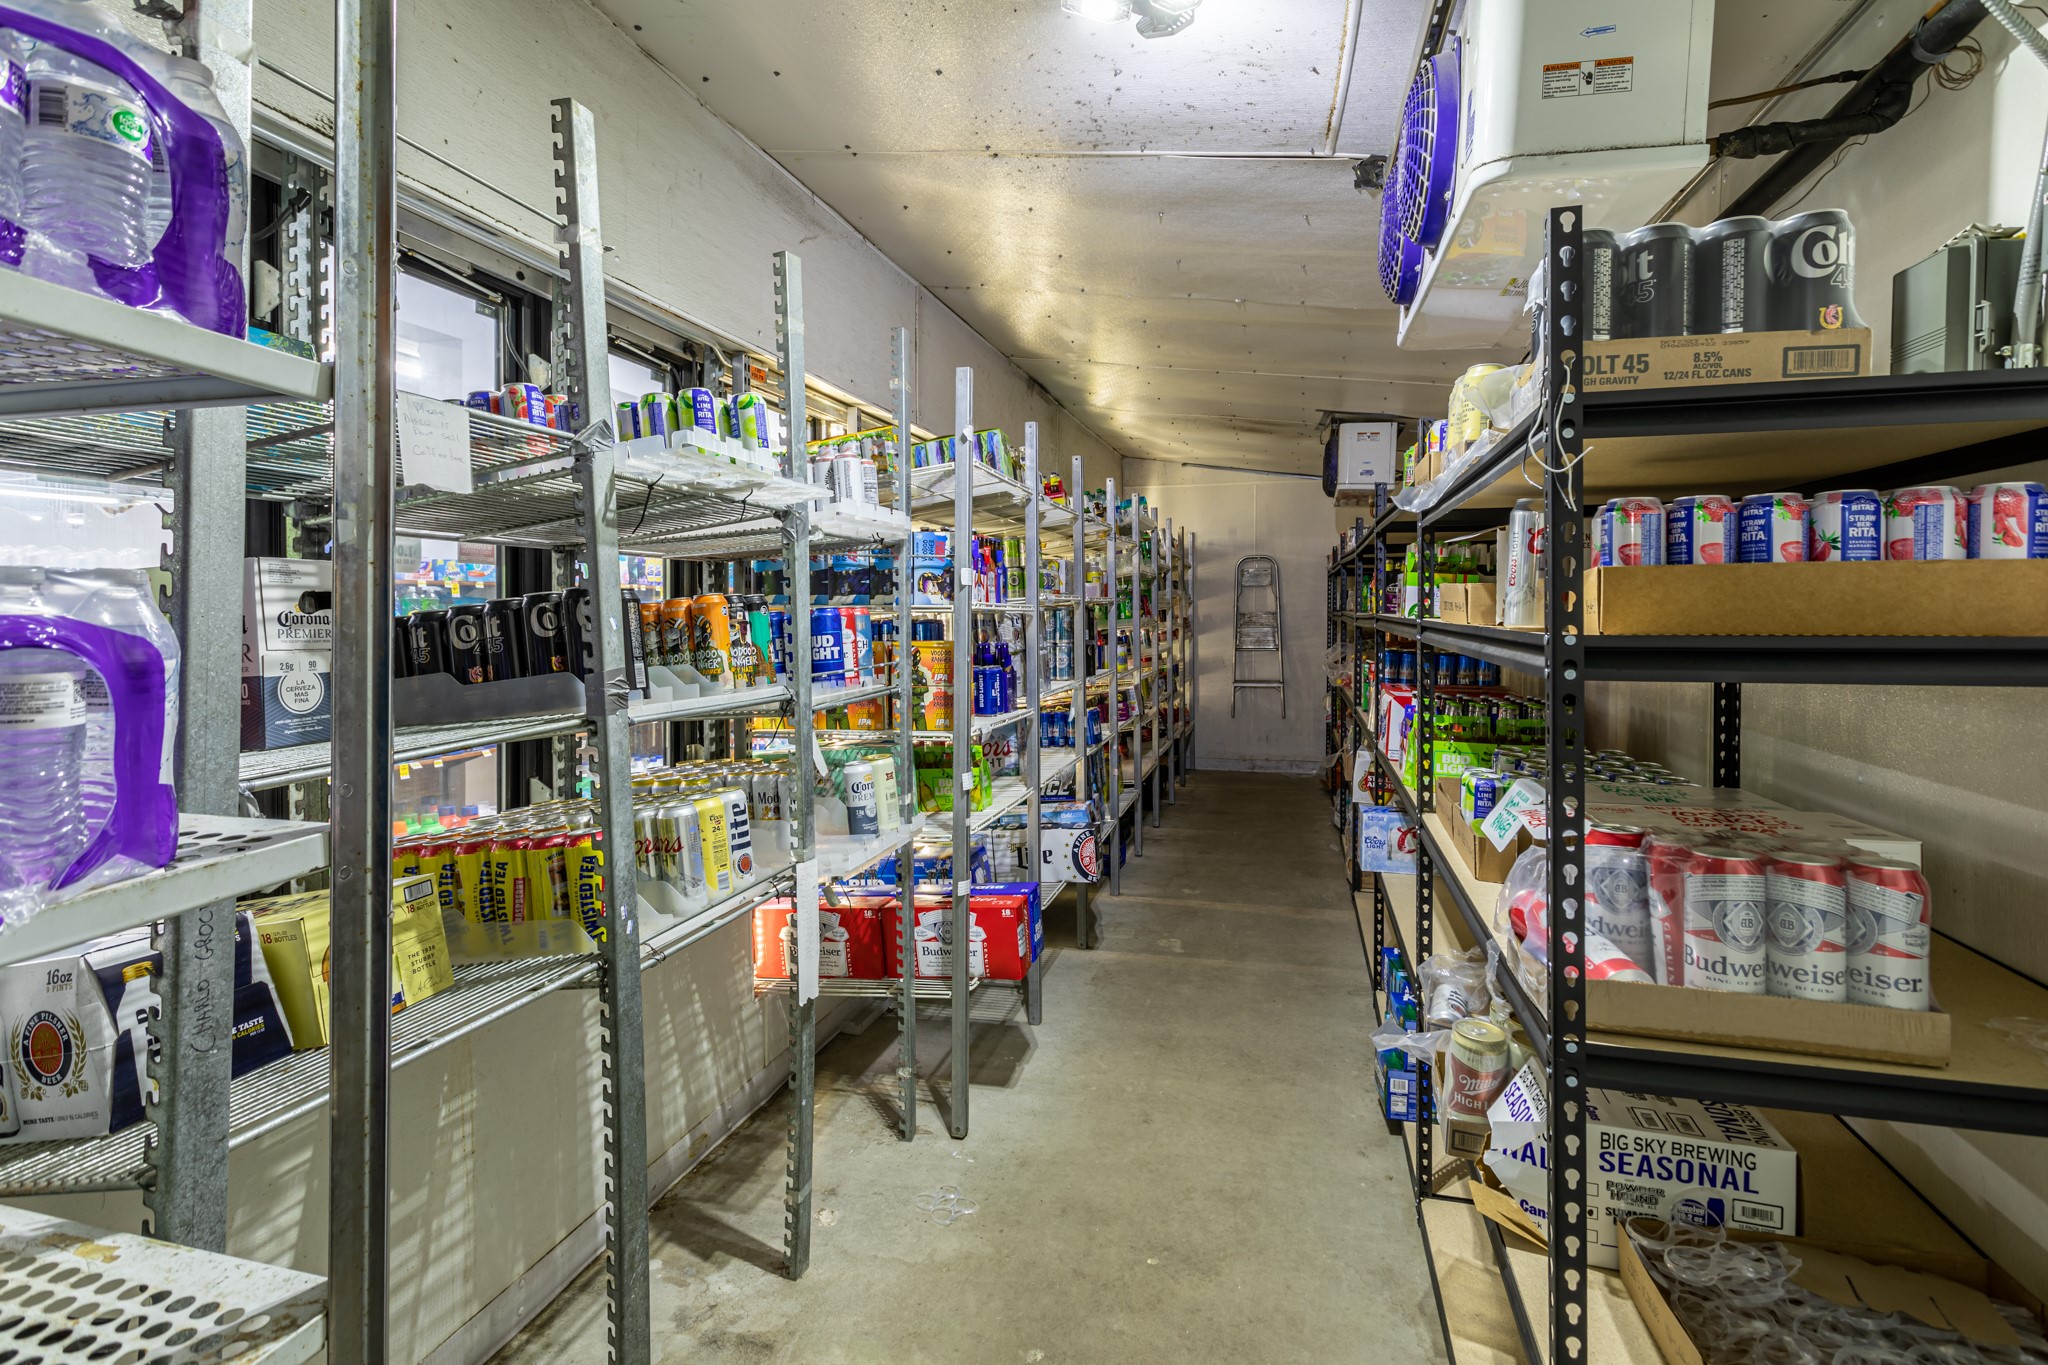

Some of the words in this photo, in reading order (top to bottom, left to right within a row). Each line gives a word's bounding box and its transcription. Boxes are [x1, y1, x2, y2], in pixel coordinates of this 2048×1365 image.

[1551, 63, 1580, 71] WARNING
[1791, 225, 1855, 279] Colt
[1629, 250, 1654, 284] lt
[1693, 351, 1723, 363] 8.5%
[1583, 354, 1621, 376] OLT
[1622, 353, 1650, 374] 45
[1664, 371, 1689, 380] 12/24
[1705, 369, 1721, 379] OZ.
[1722, 368, 1752, 378] CANS
[1583, 377, 1597, 386] GH
[1600, 376, 1640, 386] GRAVITY
[697, 411, 713, 419] RITA
[1743, 508, 1764, 517] RITAS
[1851, 503, 1875, 511] RITAS
[1741, 518, 1766, 527] STRAW
[2035, 523, 2048, 533] RIT
[1741, 531, 1768, 542] RITA
[1849, 527, 1878, 537] RITA
[1509, 559, 1517, 587] Coors
[277, 610, 331, 630] Corona
[277, 628, 332, 639] PREMIER
[812, 647, 840, 660] GHT
[280, 662, 294, 672] 2.6g
[308, 660, 317, 669] 90
[286, 684, 316, 692] CERVEZA
[1442, 754, 1471, 765] BUD
[1436, 763, 1466, 774] LIGH
[851, 781, 874, 794] Coro
[935, 787, 953, 795] LIG
[852, 794, 875, 802] PREM
[1075, 830, 1091, 847] FINE
[479, 860, 492, 885] TEA
[494, 861, 509, 881] TEA
[580, 856, 597, 880] TEA
[439, 863, 455, 887] TEA
[406, 904, 416, 914] 18
[416, 901, 436, 911] BOTTLES
[261, 934, 272, 944] 18
[274, 934, 297, 943] BOTTLES
[408, 951, 420, 960] THE
[422, 944, 436, 954] 1936
[1664, 922, 1675, 983] GENUIN
[411, 952, 435, 967] STUBBY
[1685, 944, 1766, 978] Budwei
[412, 960, 436, 975] BOTTLE
[46, 968, 73, 985] 16oz
[1706, 975, 1732, 985] KING
[52, 983, 73, 992] PINTS
[25, 1014, 40, 1038] FINE
[41, 1012, 69, 1042] PILSNER
[237, 1016, 264, 1032] TASTE
[237, 1023, 265, 1038] CALORIES
[41, 1074, 63, 1085] BEER
[1519, 1066, 1533, 1082] BIG
[1525, 1077, 1540, 1096] SKY
[1454, 1091, 1482, 1110] HIGH
[23, 1117, 37, 1125] MORE
[38, 1116, 54, 1124] TASTE
[75, 1111, 99, 1119] CALORIES
[1600, 1132, 1629, 1150] BIG
[1633, 1136, 1667, 1153] SKY
[1671, 1142, 1757, 1171] BREWING
[1599, 1151, 1760, 1195] SEASONAL
[1606, 1180, 1666, 1198] POWDER
[1610, 1189, 1660, 1206] HOUND
